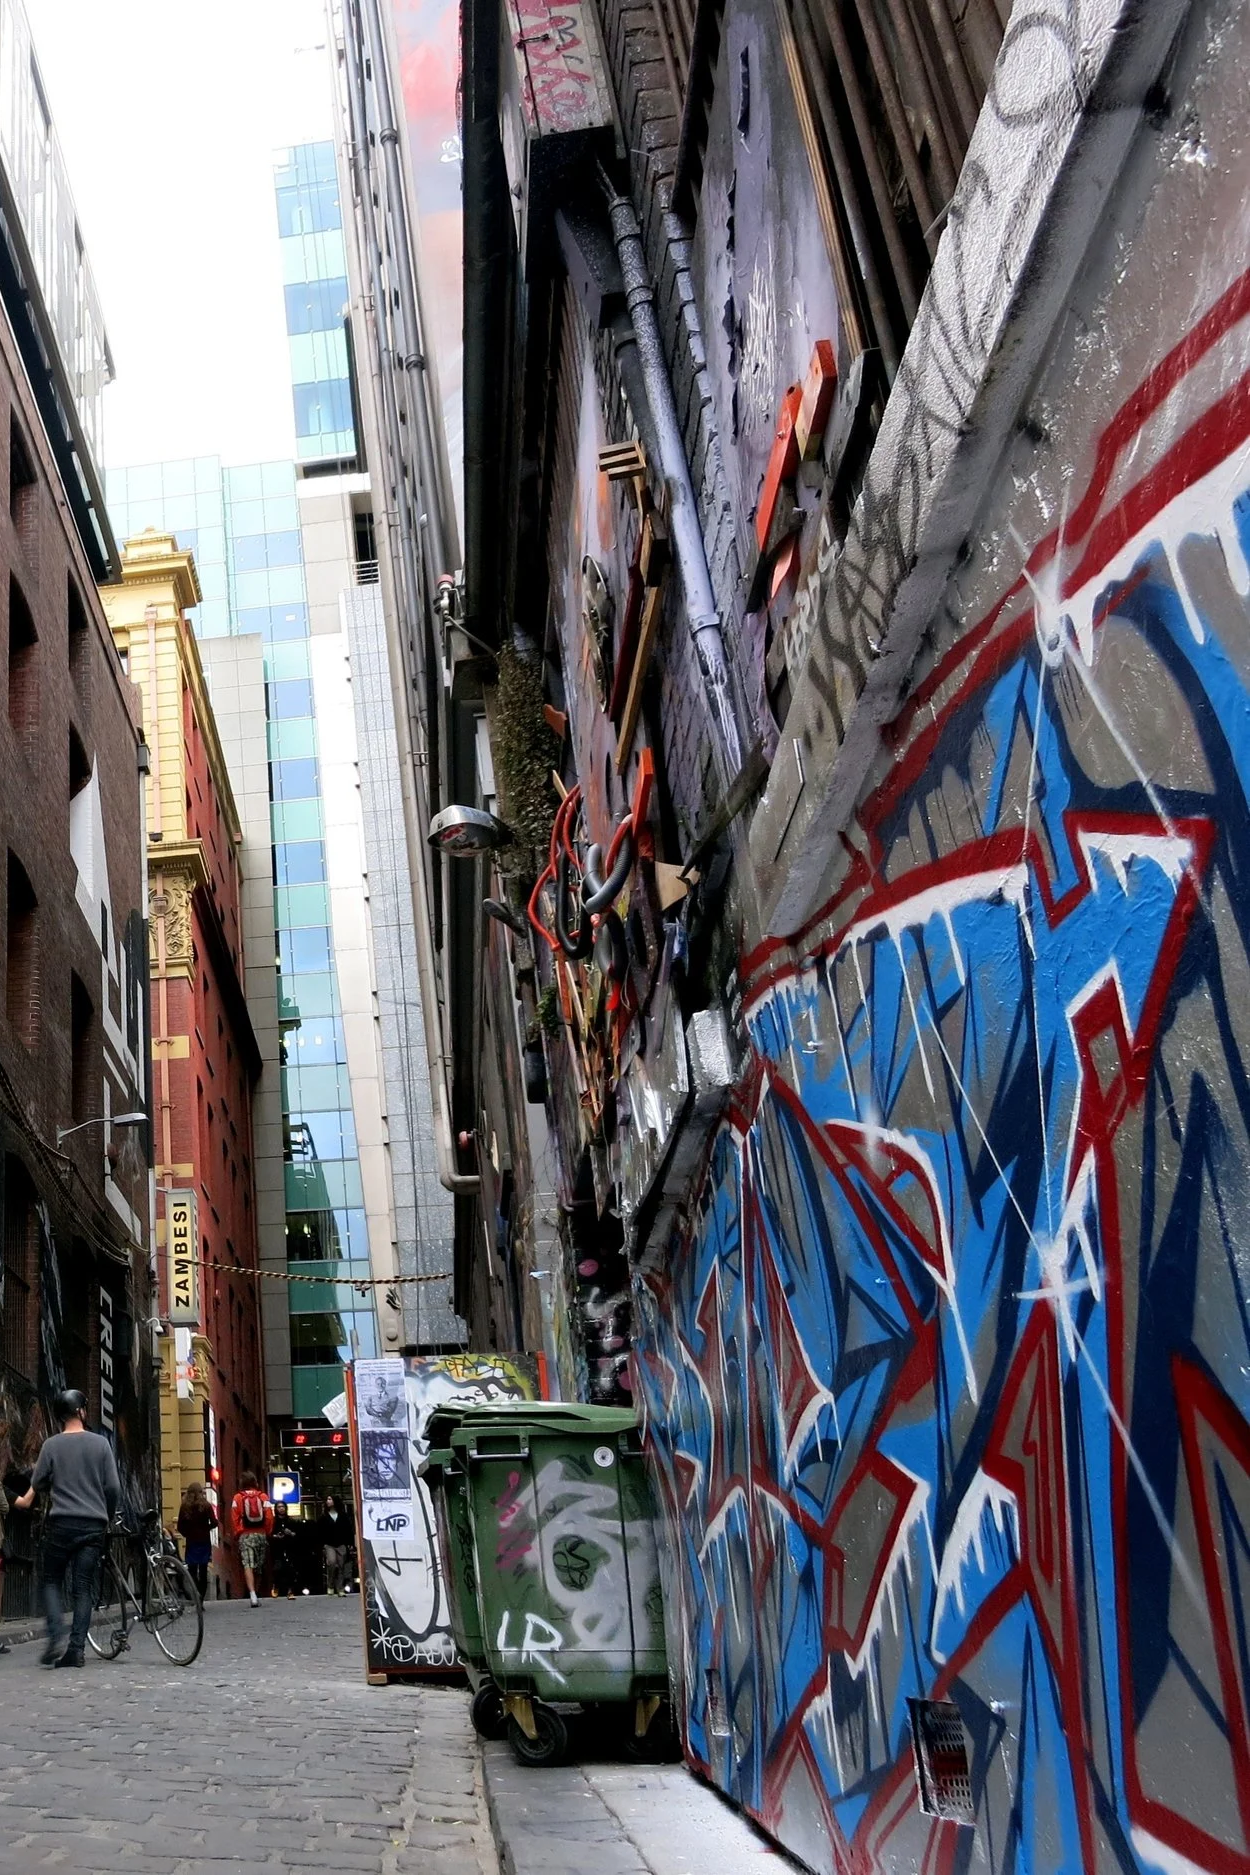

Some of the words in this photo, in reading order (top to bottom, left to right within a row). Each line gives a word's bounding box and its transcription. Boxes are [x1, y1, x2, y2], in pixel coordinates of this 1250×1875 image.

[172, 1202, 190, 1307] ZAMBESI
[99, 1285, 115, 1432] CREW
[272, 1477, 295, 1500] P
[376, 1517, 407, 1532] LNP
